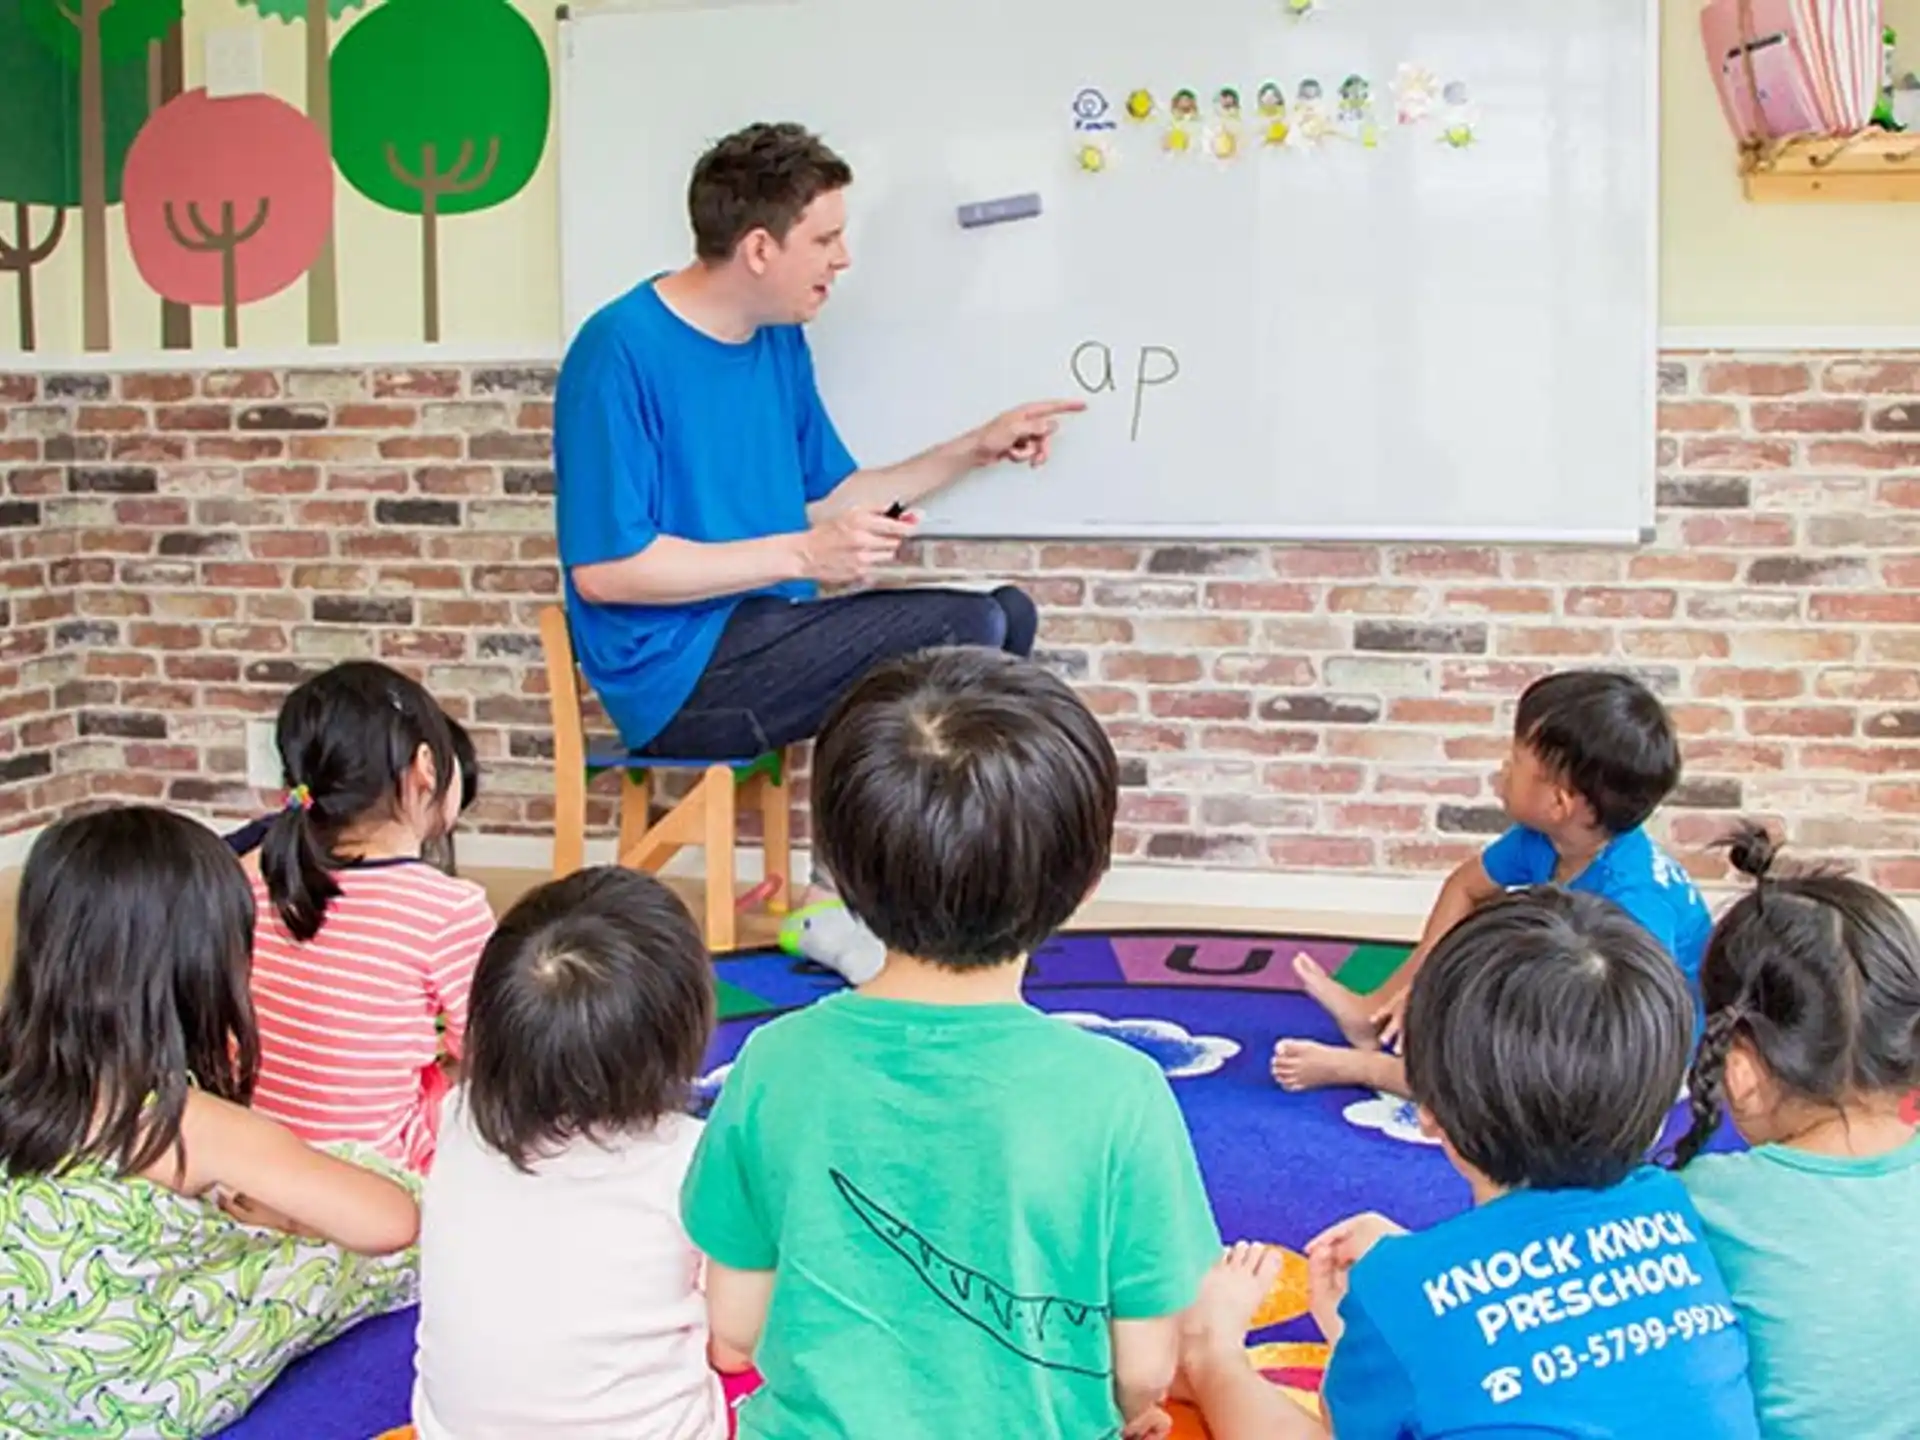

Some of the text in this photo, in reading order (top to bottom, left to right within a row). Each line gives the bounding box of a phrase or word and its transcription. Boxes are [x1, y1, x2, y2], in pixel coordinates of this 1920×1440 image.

[1165, 945, 1274, 975] U
[1423, 1210, 1697, 1316] KNOCK KNOCK
[1476, 1252, 1702, 1345] PRESCHOOL
